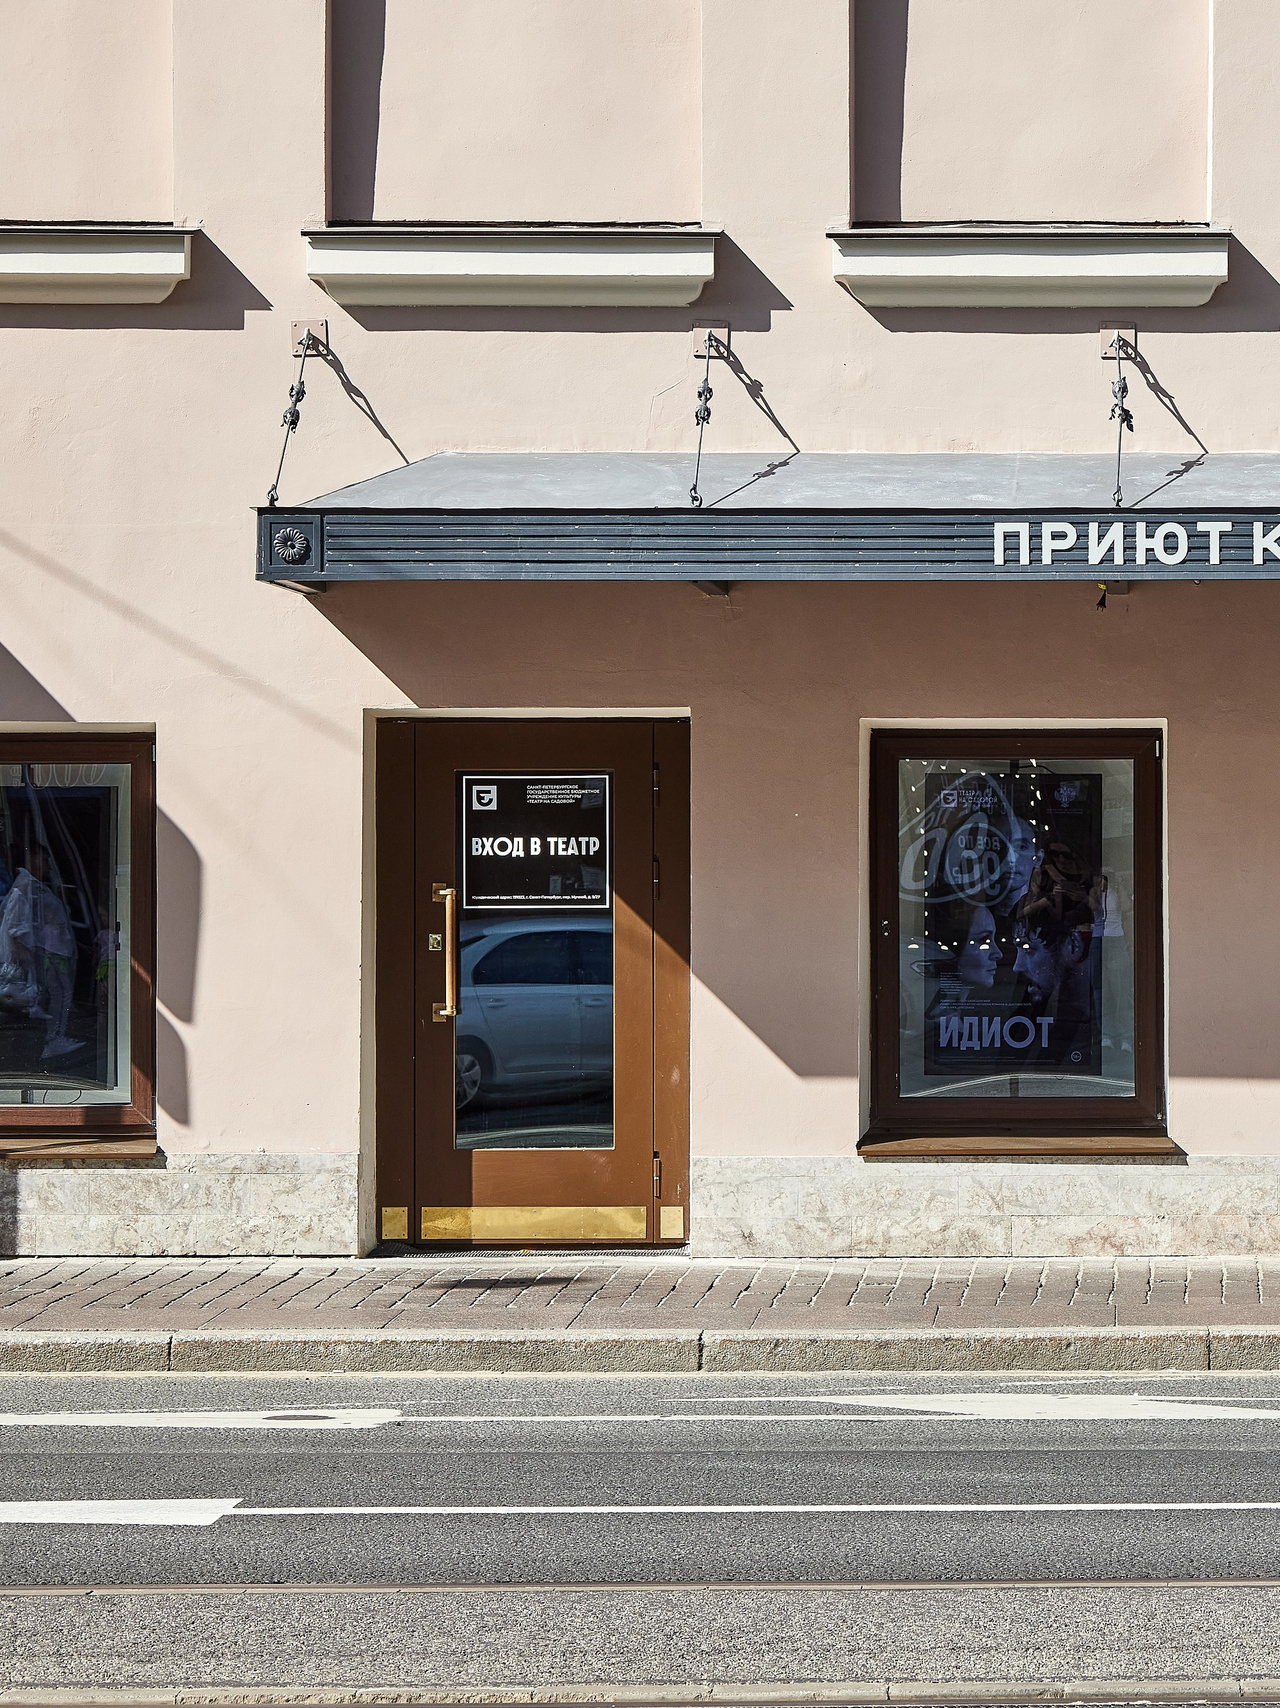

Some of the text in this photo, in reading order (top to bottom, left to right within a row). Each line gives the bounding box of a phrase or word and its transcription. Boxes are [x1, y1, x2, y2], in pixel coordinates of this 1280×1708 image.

[994, 522, 1232, 566] ПРИЮТ
[472, 837, 600, 857] ВХОД В ТЕАТР
[939, 1016, 1054, 1050] ИДИОТ
